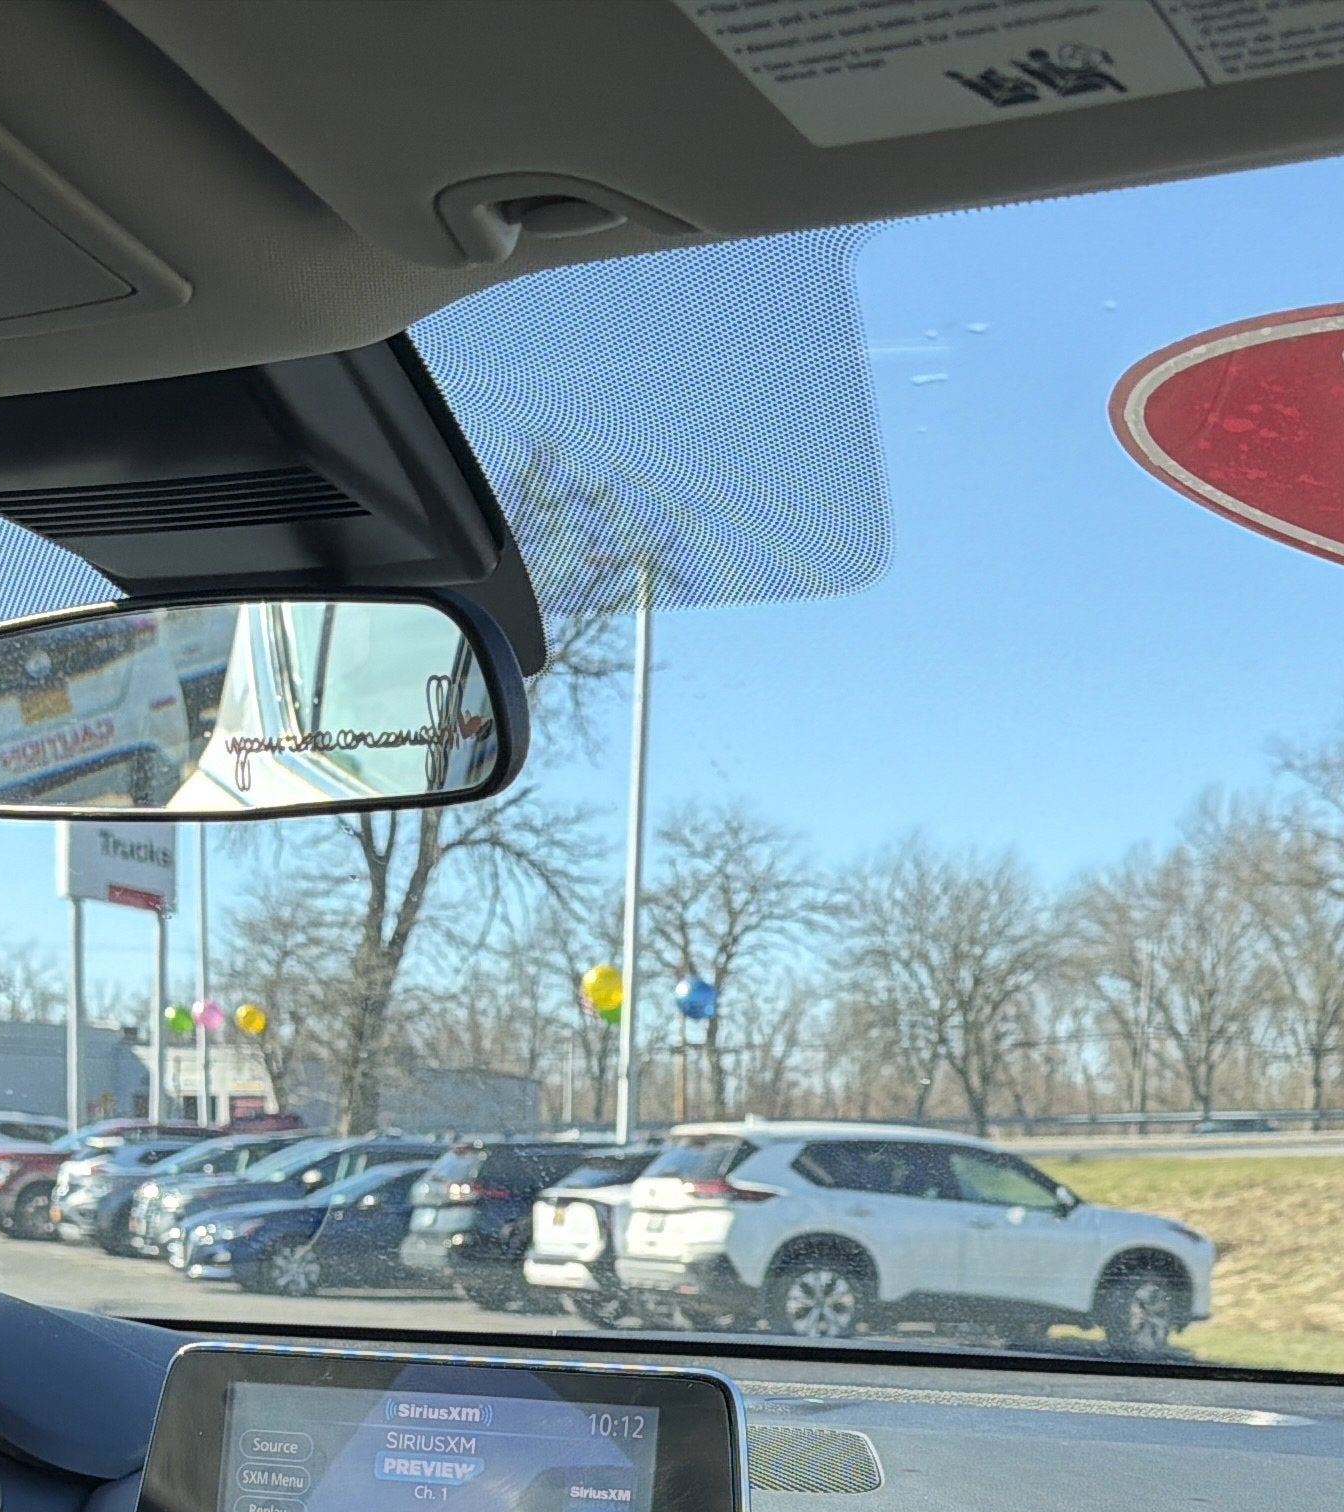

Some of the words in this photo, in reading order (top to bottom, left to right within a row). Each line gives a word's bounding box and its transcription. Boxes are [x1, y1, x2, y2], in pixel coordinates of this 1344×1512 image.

[588, 1413, 644, 1439] 10:12
[253, 1437, 298, 1453] Source
[386, 1431, 476, 1454] SIRIUSXM
[383, 1457, 475, 1479] PREVIEW
[242, 1469, 268, 1485] SXM
[271, 1472, 304, 1488] Menu
[414, 1485, 435, 1500] Ch.
[441, 1487, 448, 1500] 1
